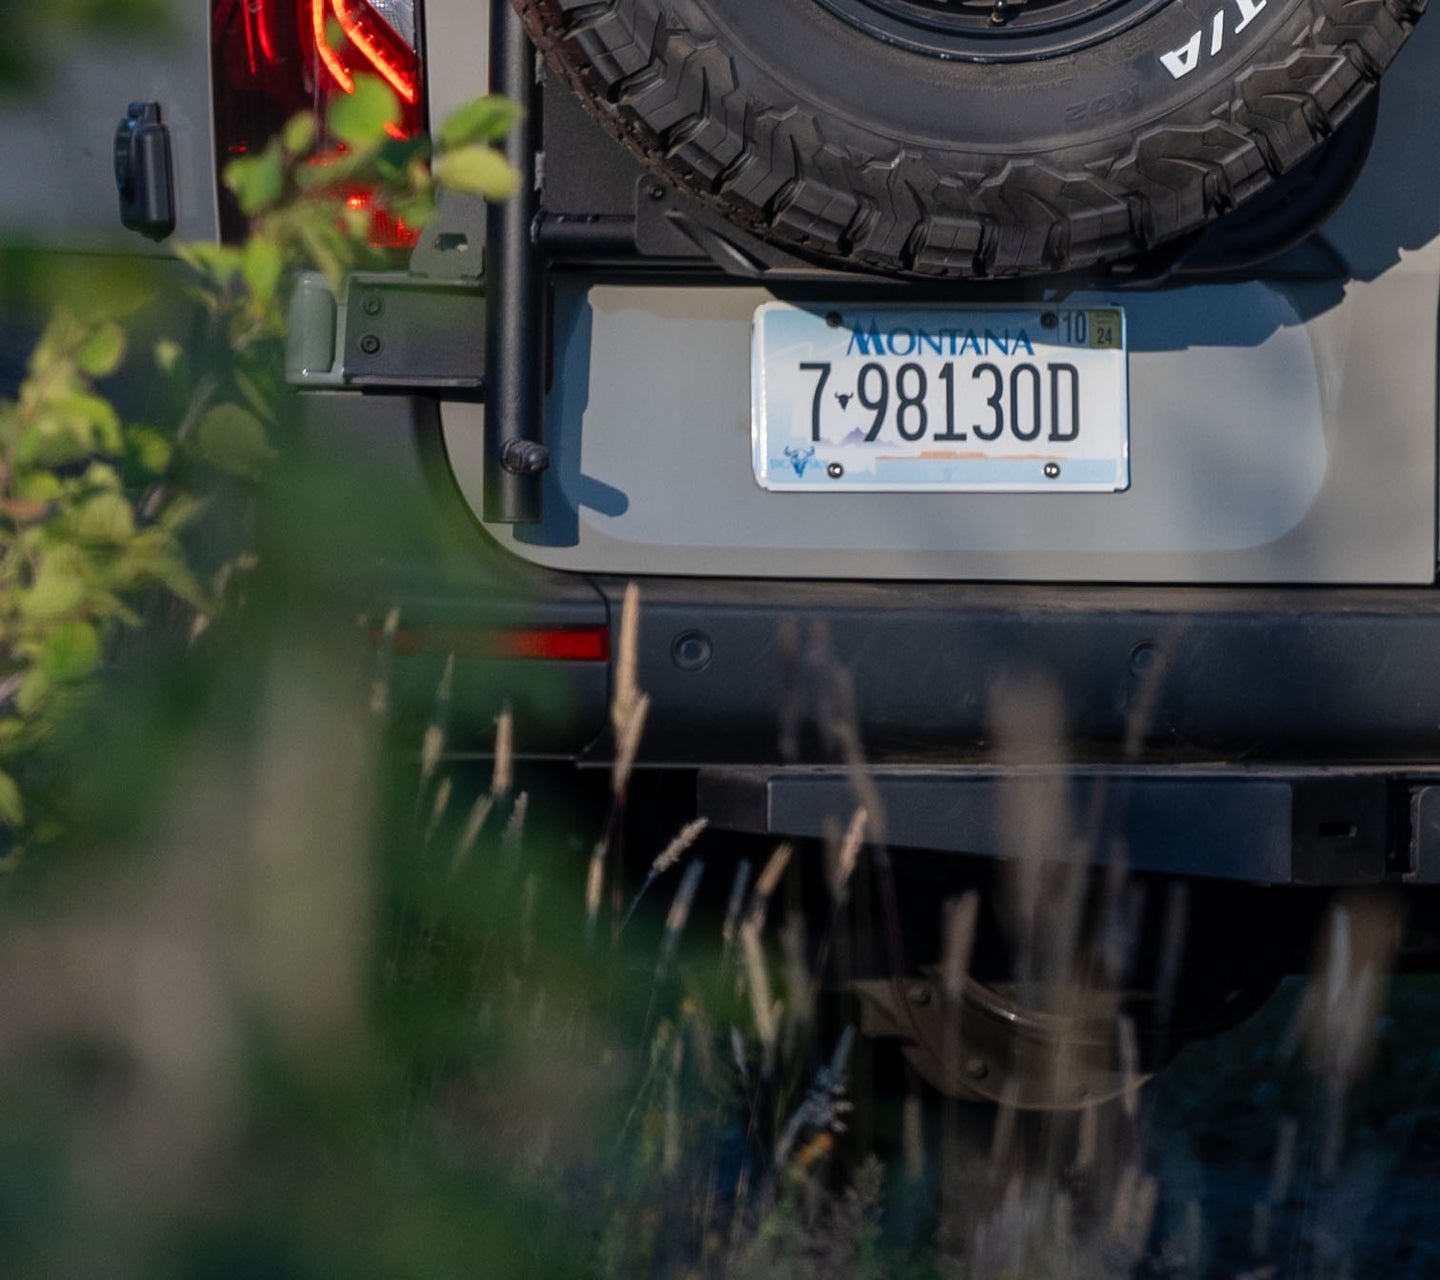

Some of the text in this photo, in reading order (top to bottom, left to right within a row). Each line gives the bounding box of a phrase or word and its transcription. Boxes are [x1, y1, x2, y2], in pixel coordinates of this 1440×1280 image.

[847, 317, 1036, 357] MONTANA
[1063, 310, 1087, 345] 10
[1096, 327, 1113, 345] 24
